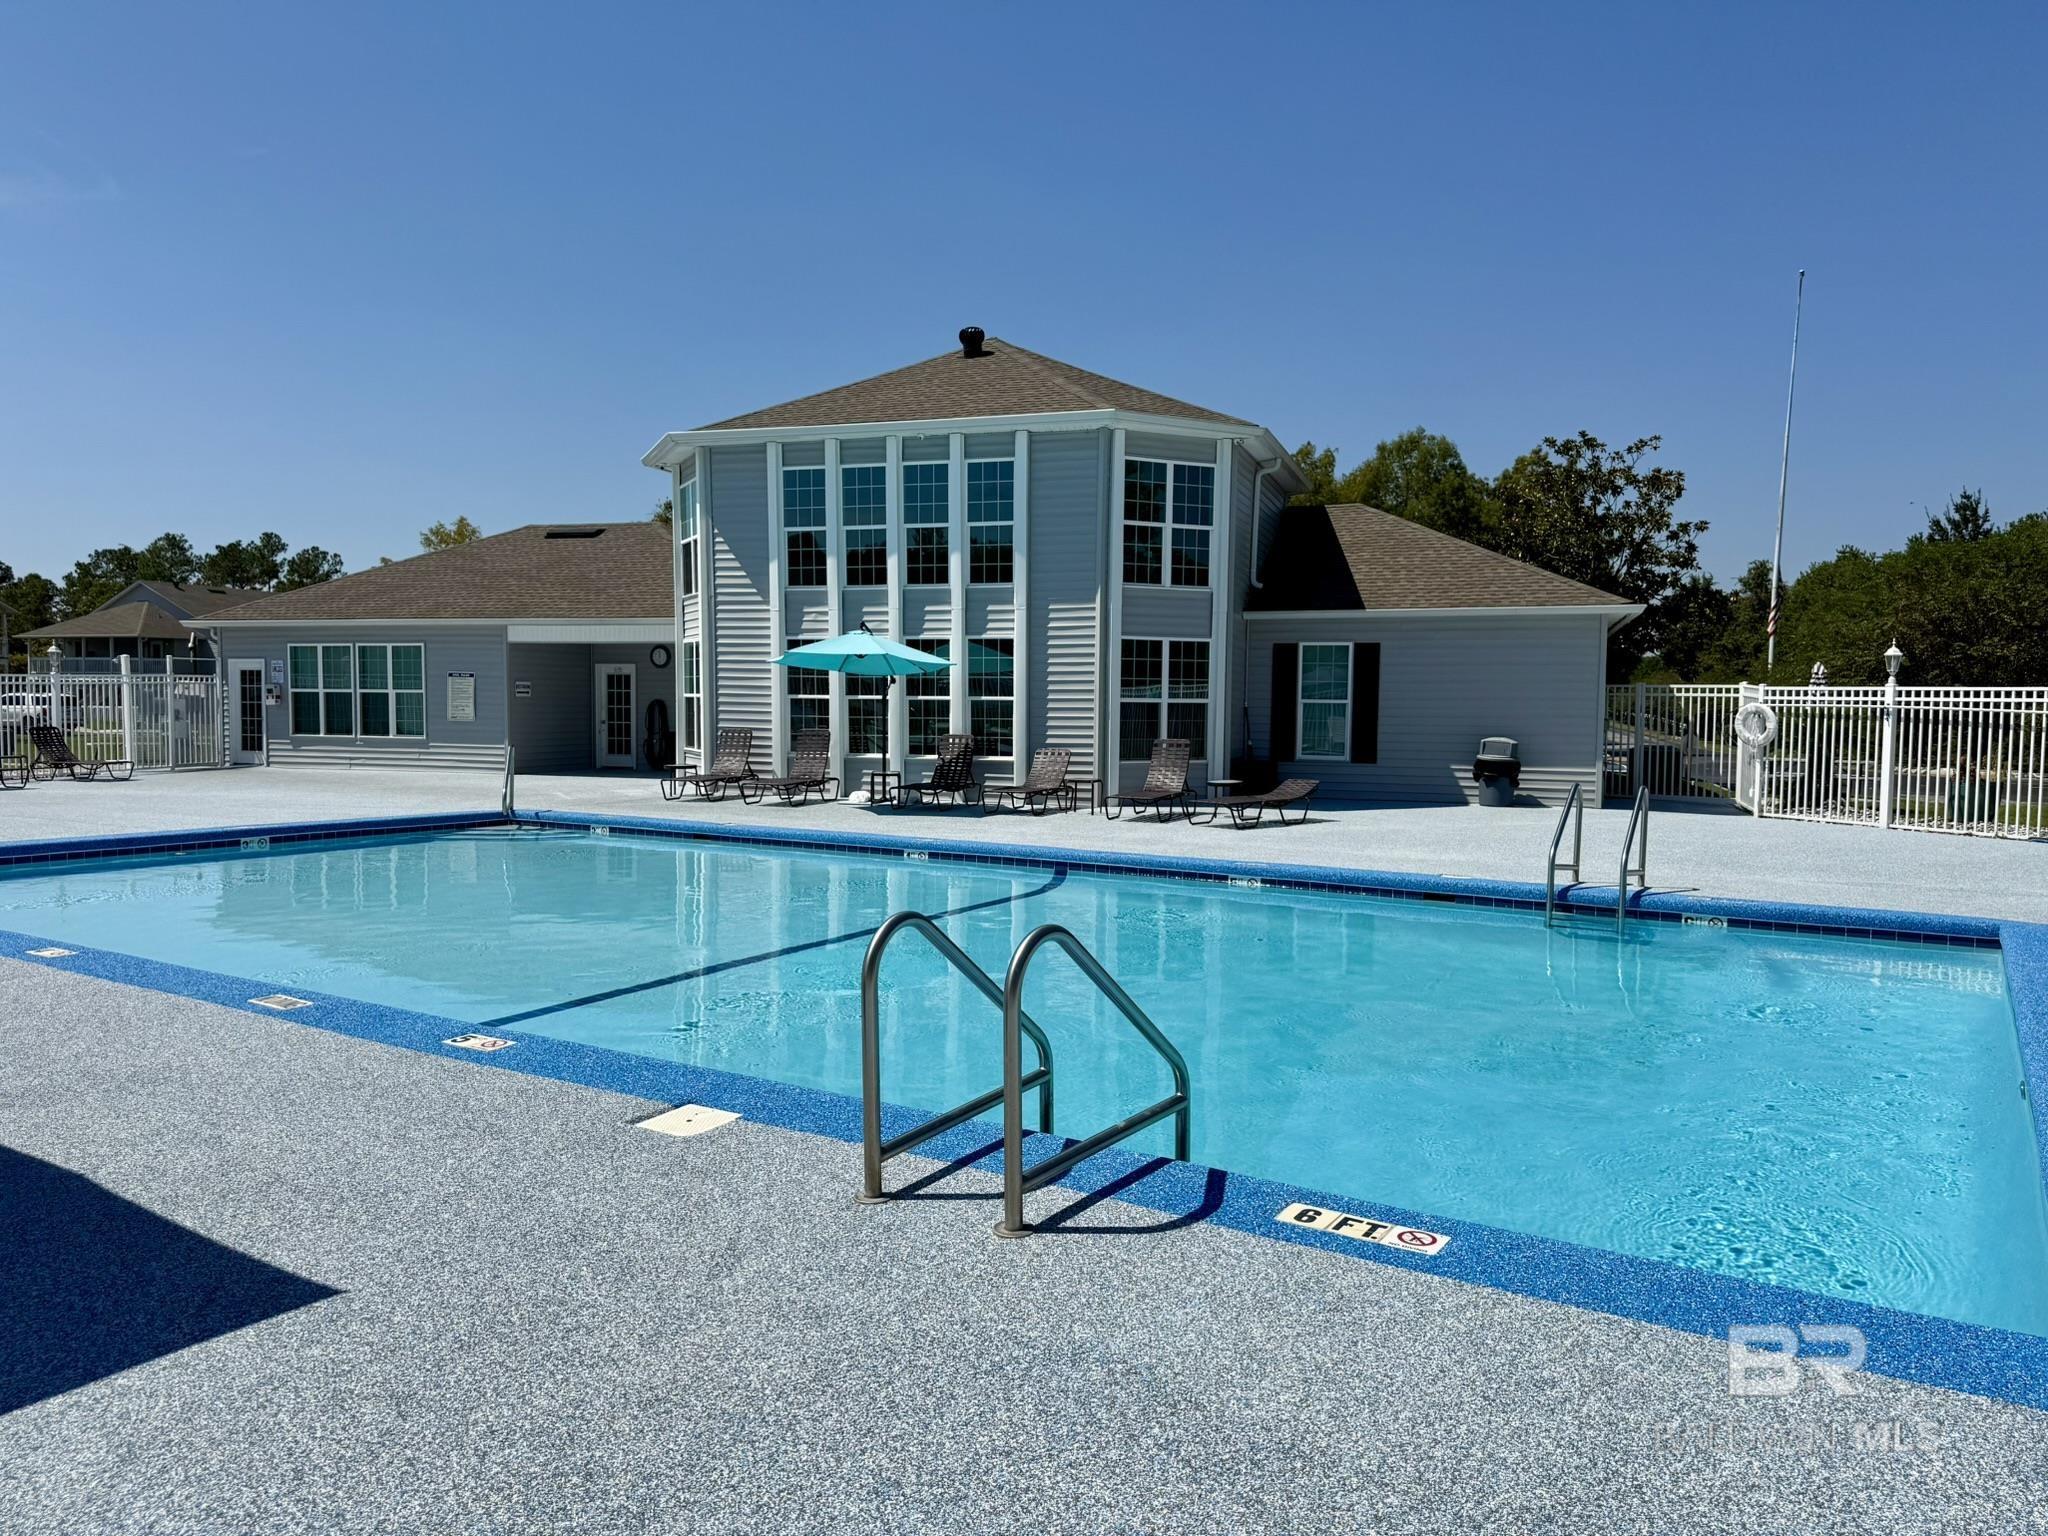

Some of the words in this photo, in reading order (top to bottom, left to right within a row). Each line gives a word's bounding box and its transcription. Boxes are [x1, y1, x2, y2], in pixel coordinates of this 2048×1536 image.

[451, 1035, 478, 1043] 5
[1293, 1208, 1322, 1223] 6
[1331, 1216, 1389, 1240] FT.
